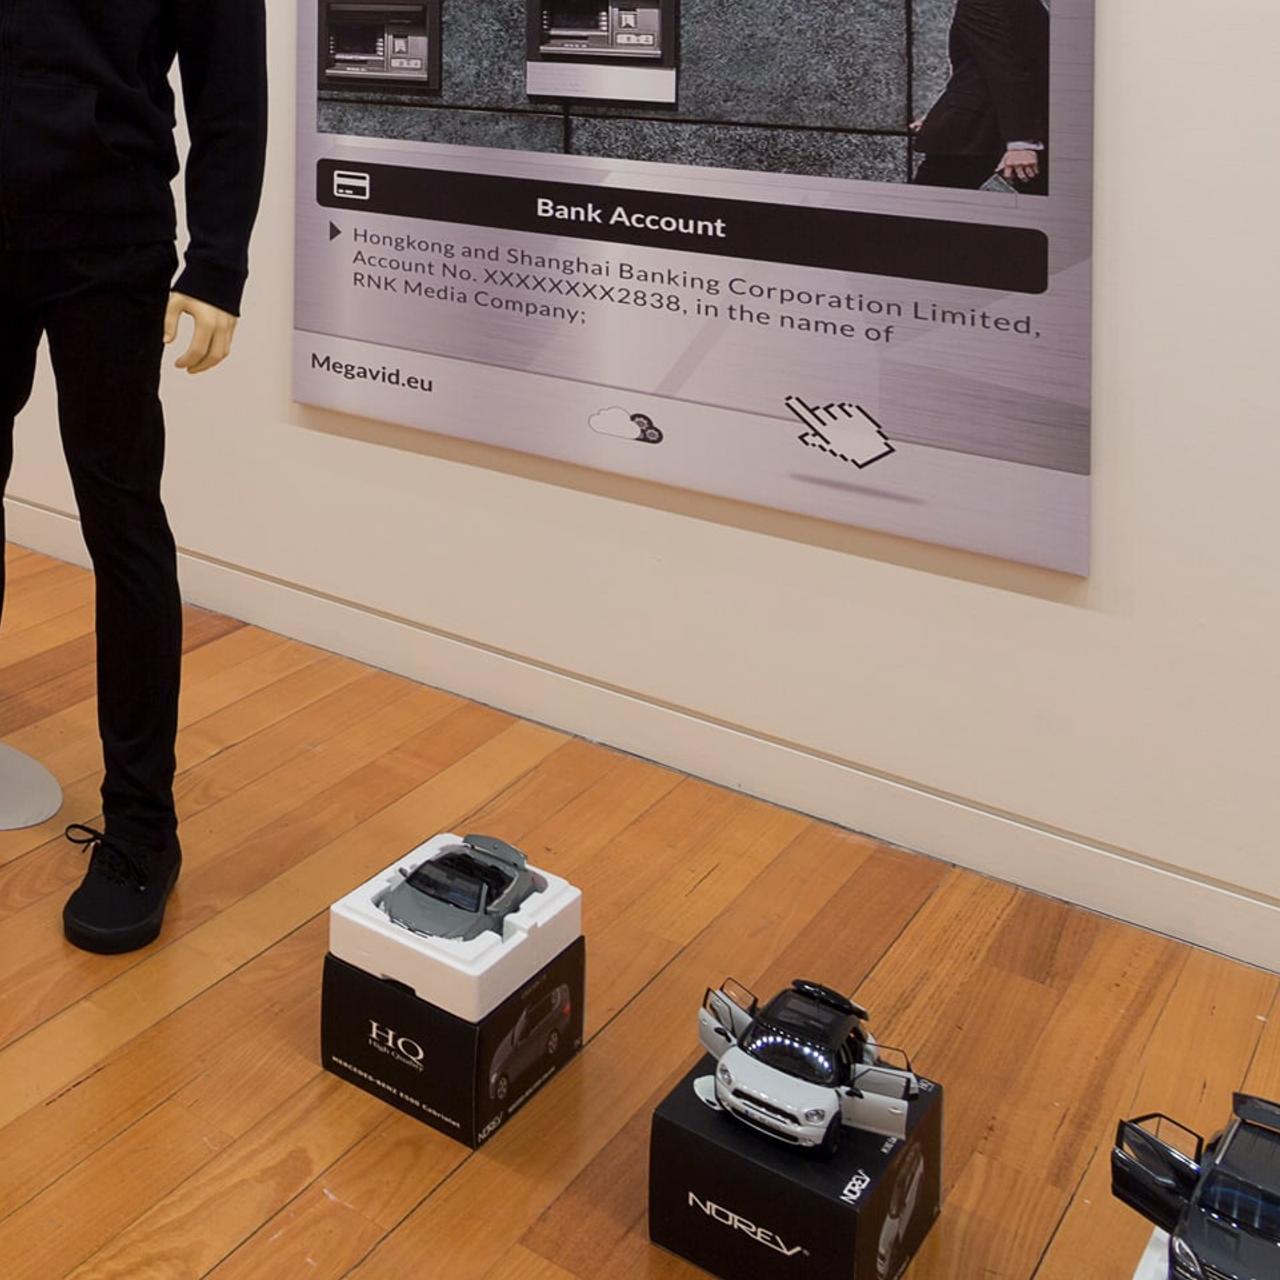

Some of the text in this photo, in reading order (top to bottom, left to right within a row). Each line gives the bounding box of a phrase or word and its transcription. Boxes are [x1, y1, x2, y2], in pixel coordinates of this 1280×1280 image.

[537, 198, 726, 238] Bank Account
[353, 251, 895, 343] Account No. XXXXXXXX2838, in the name of
[353, 272, 586, 325] RNK Media Company;
[354, 227, 1041, 339] Hongkong and Shanghai Banking Corporation Limited,
[311, 352, 434, 393] Megavid.eu
[369, 1020, 424, 1067] HQ
[840, 1169, 871, 1205] NOREV
[688, 1191, 804, 1256] NOREV
